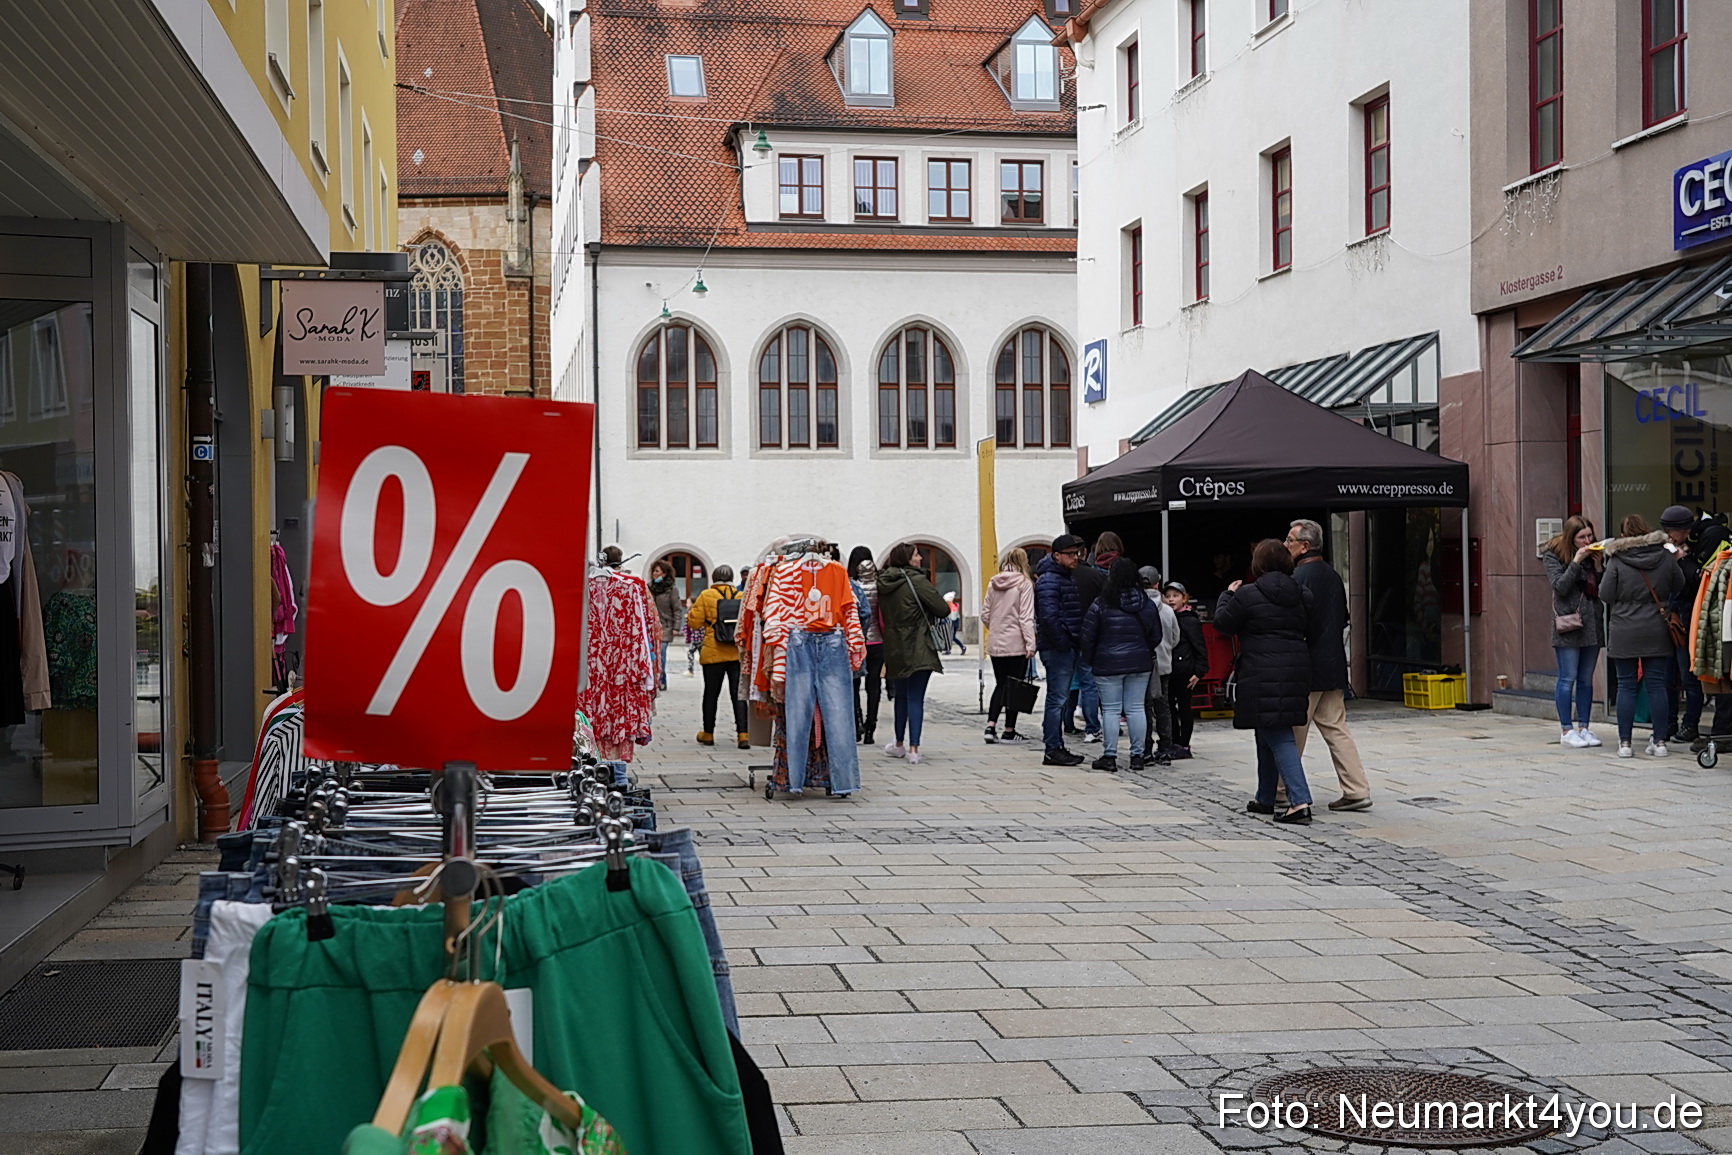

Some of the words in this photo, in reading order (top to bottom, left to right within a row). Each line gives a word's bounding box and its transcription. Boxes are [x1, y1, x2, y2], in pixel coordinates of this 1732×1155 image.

[1500, 270, 1555, 296] Klostergasse
[1557, 265, 1563, 280] 2
[289, 306, 358, 341] Sarah
[360, 308, 380, 341] K
[1635, 383, 1707, 424] CECIL
[1675, 421, 1705, 502] ECIL
[1179, 477, 1245, 501] Crêpes
[1337, 482, 1454, 497] www.creppresso.de
[340, 445, 556, 721] %
[196, 983, 212, 1040] ITALY
